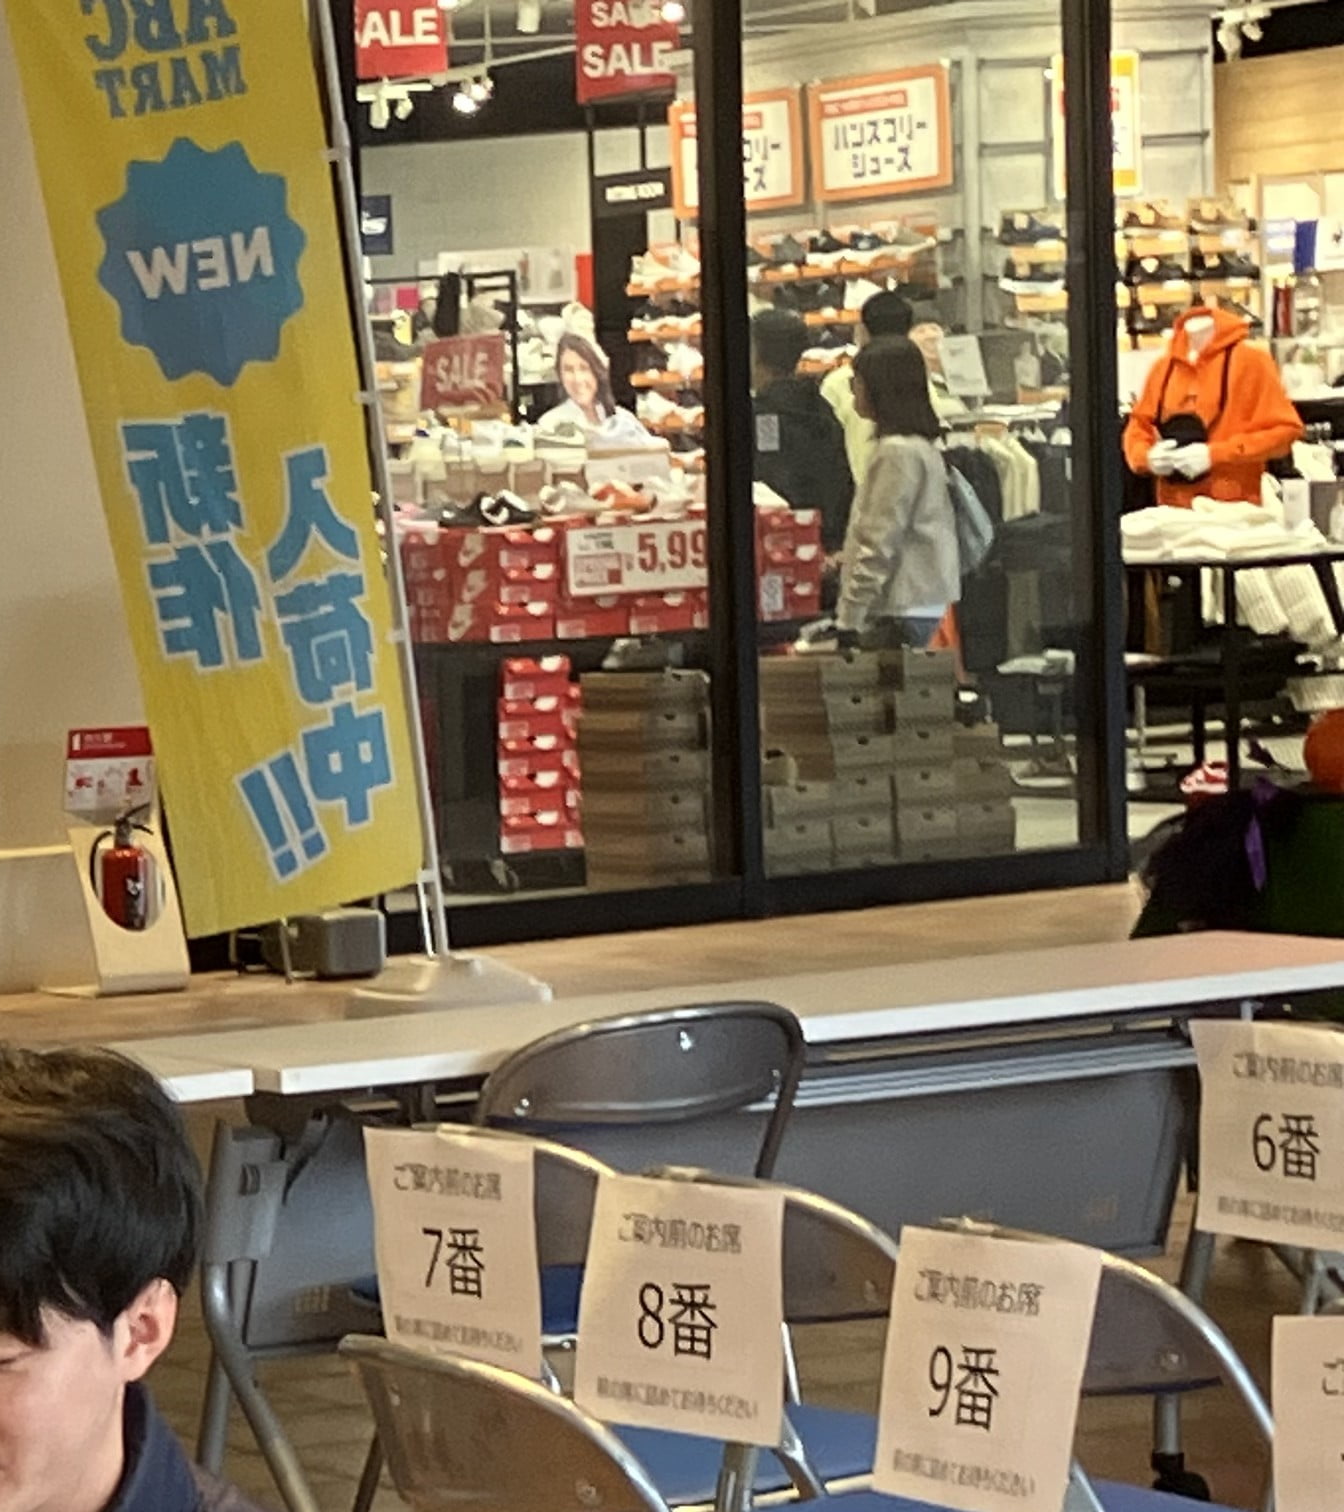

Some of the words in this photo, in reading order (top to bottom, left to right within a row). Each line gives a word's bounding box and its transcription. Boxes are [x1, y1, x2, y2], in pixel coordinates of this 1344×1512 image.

[355, 7, 440, 49] ALE
[582, 41, 673, 79] SALE
[1252, 1112, 1321, 1182] 6番
[421, 1226, 486, 1300] 7番
[636, 1281, 718, 1361] 8番
[928, 1344, 1000, 1432] 9番
